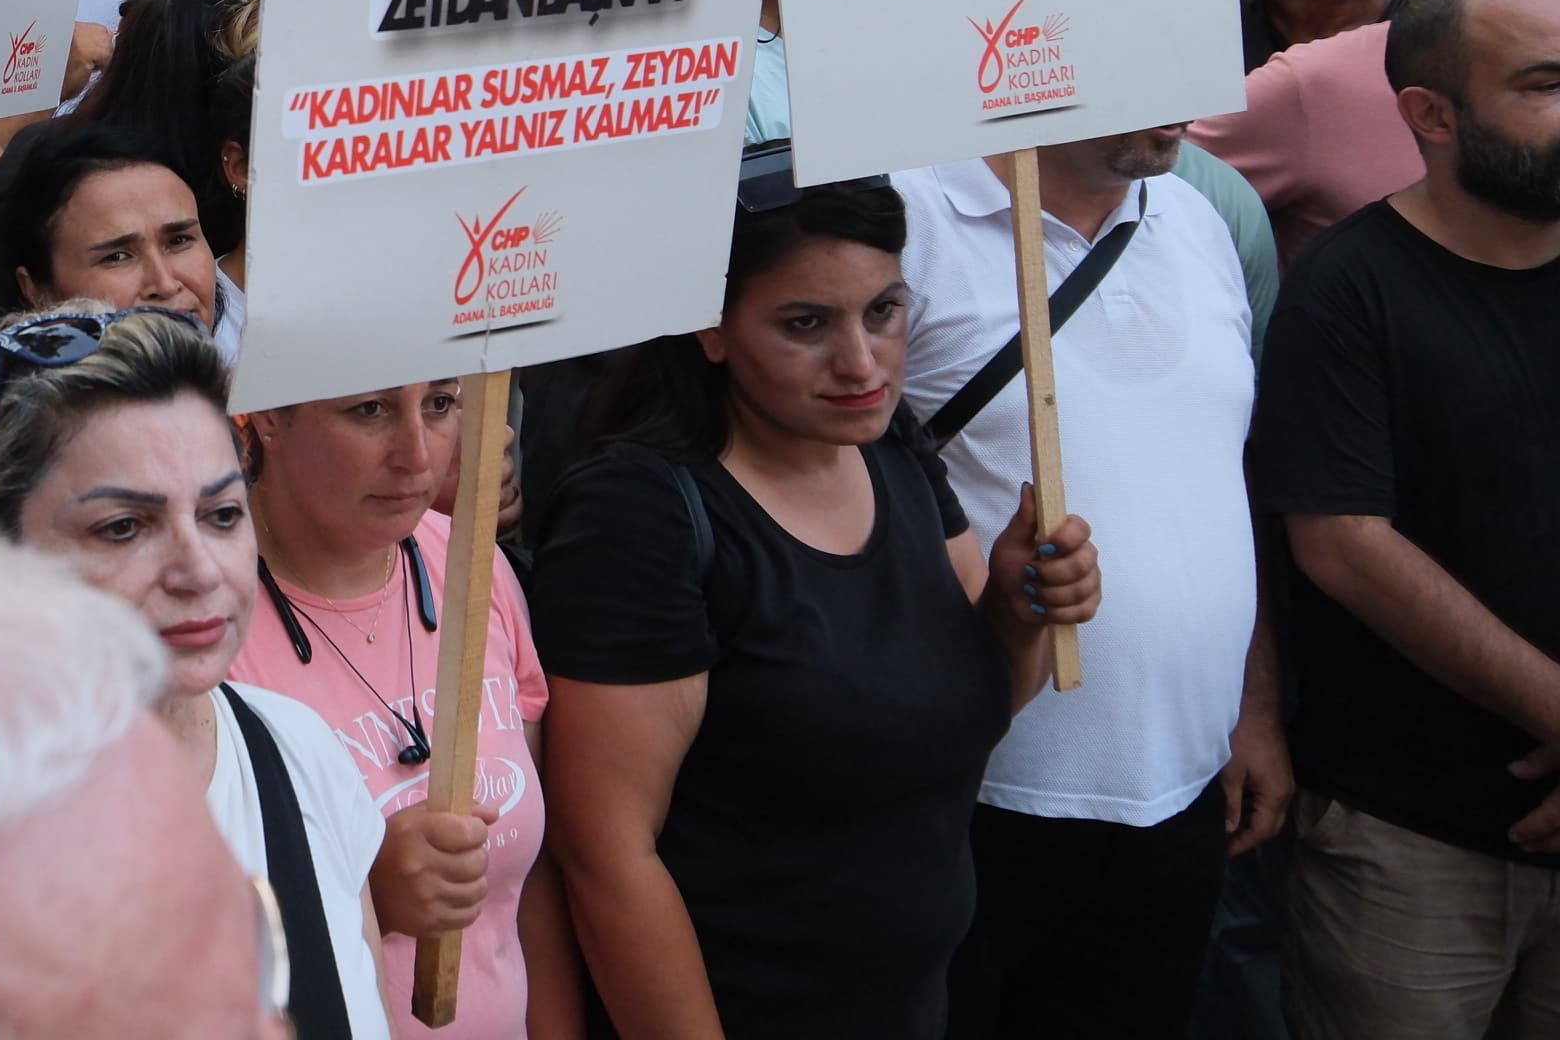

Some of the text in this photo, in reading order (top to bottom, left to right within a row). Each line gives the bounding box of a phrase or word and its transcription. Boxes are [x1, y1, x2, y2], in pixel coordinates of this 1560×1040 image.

[19, 41, 35, 56] CHP
[1005, 26, 1040, 48] CHP
[16, 55, 40, 69] KADIN
[1006, 45, 1061, 69] KADIN
[14, 68, 42, 82] KOLLARI
[289, 41, 739, 130] “KADINLAR SUSMAZ, ZEYDAN
[1008, 64, 1076, 91] KOLLARI
[982, 97, 1012, 111] ADANA
[1025, 85, 1076, 103] BAŞKANLIĞI
[301, 88, 720, 181] KARALAR YALNIZ KALMAZ!”
[491, 226, 530, 252] CHP
[488, 248, 547, 276] KADIN
[485, 271, 558, 302] KOLLARI
[452, 309, 485, 326] ADANA
[499, 294, 554, 318] BAŞKANLIĞI
